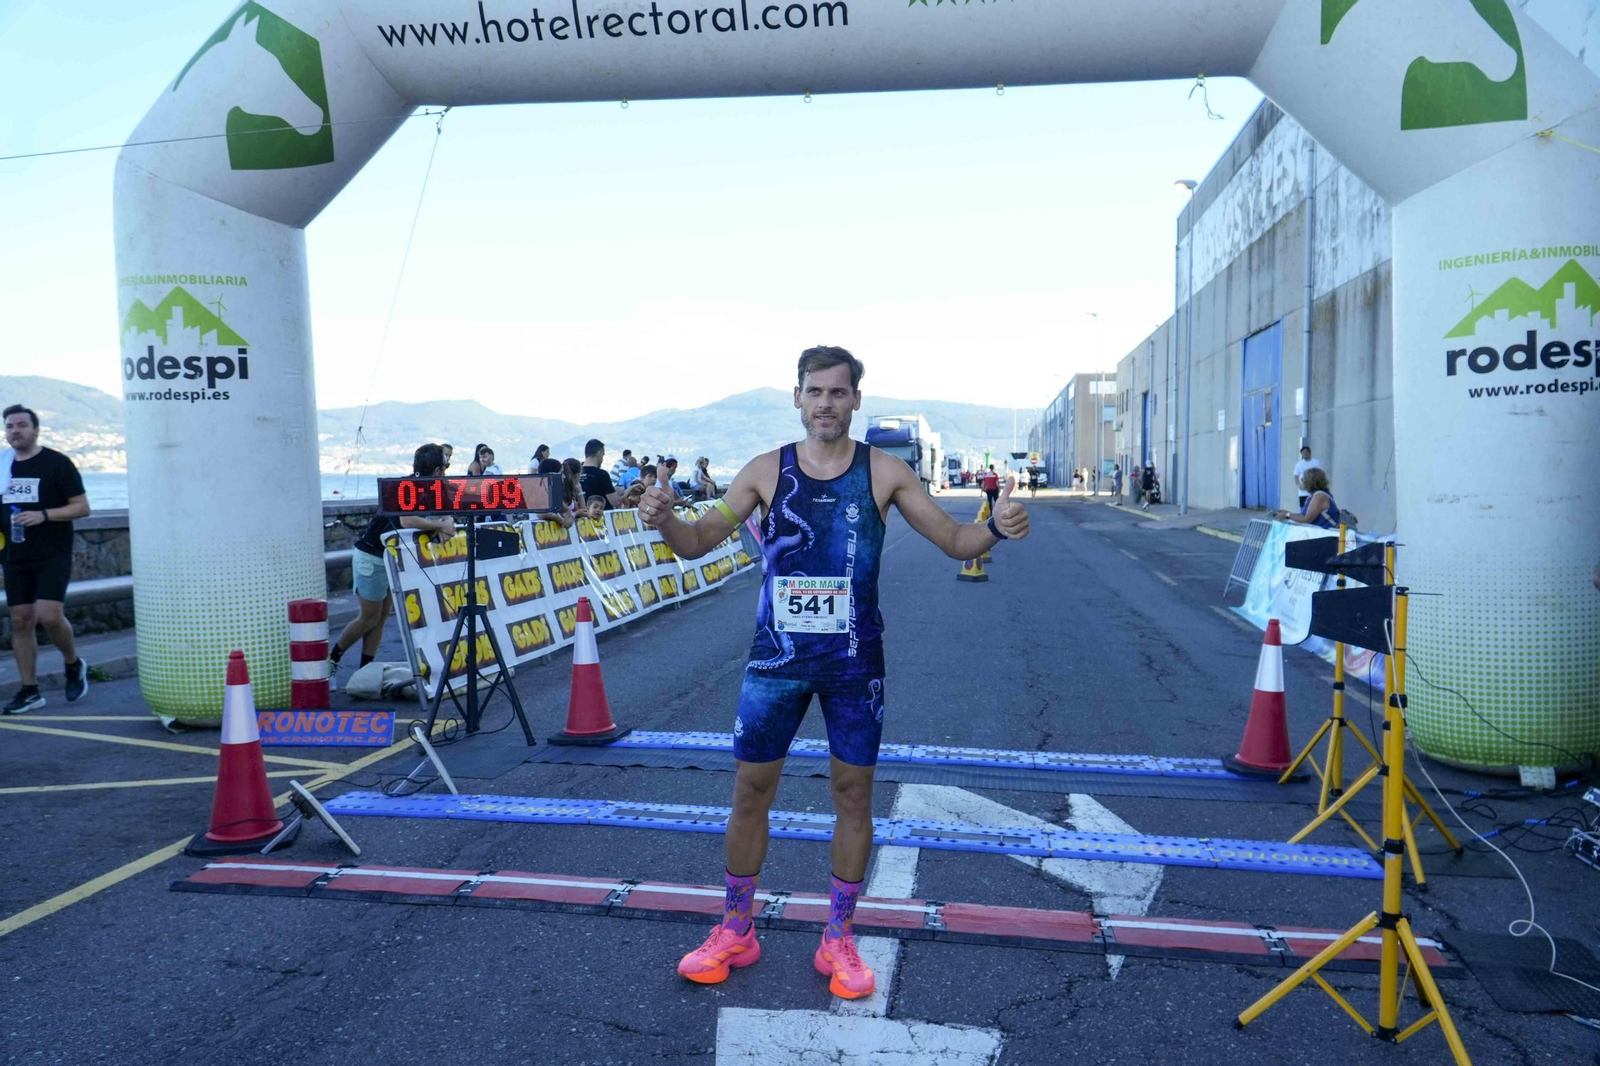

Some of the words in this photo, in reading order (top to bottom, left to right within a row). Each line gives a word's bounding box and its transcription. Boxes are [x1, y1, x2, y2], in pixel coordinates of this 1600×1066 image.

[377, 0, 849, 47] www.hotelrectoral.com
[122, 345, 249, 389] odespi
[1446, 330, 1600, 377] rodes
[1468, 377, 1600, 398] www.rodespi.
[398, 478, 521, 511] 0:17:09
[798, 580, 817, 589] POR
[788, 595, 835, 615] 541
[1219, 849, 1369, 867] CRONOTEC
